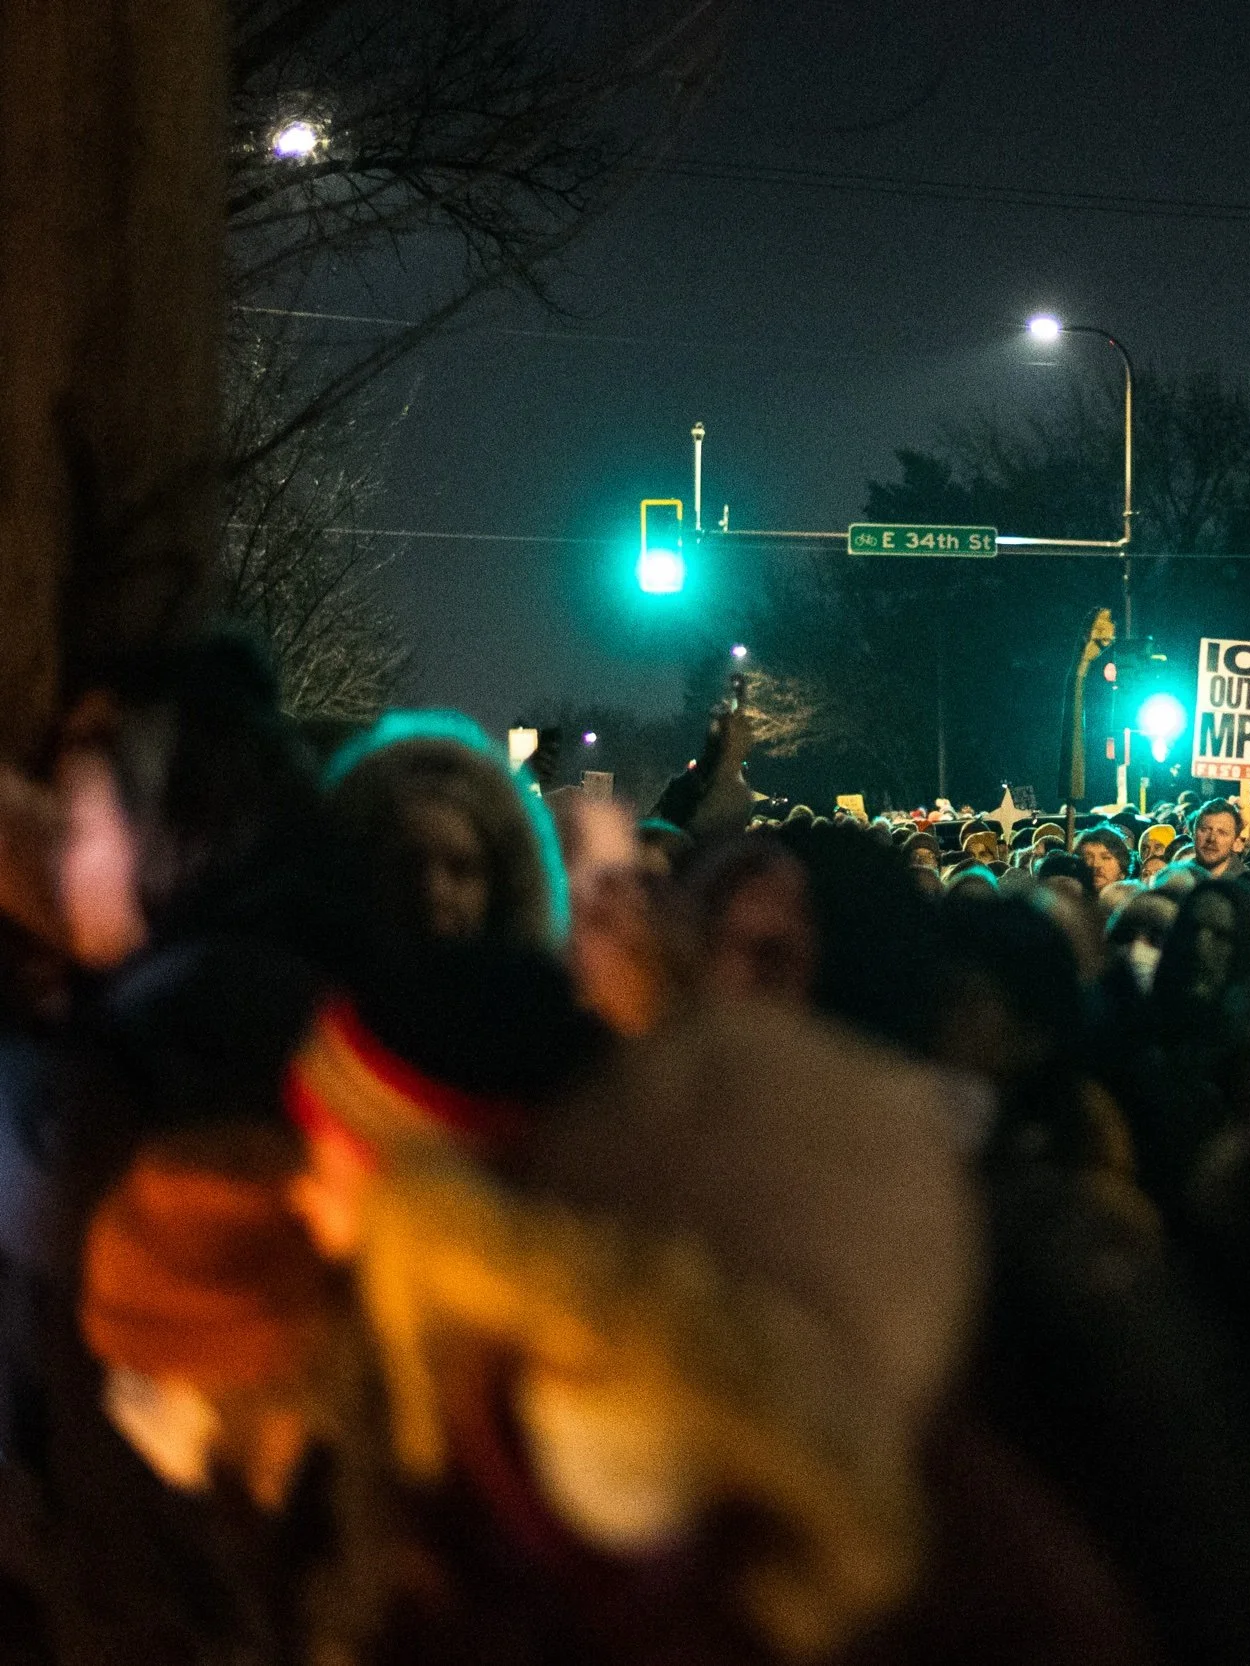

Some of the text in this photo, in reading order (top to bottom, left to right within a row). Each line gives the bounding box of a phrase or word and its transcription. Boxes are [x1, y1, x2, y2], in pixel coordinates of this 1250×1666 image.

[882, 531, 992, 550] E 34th St
